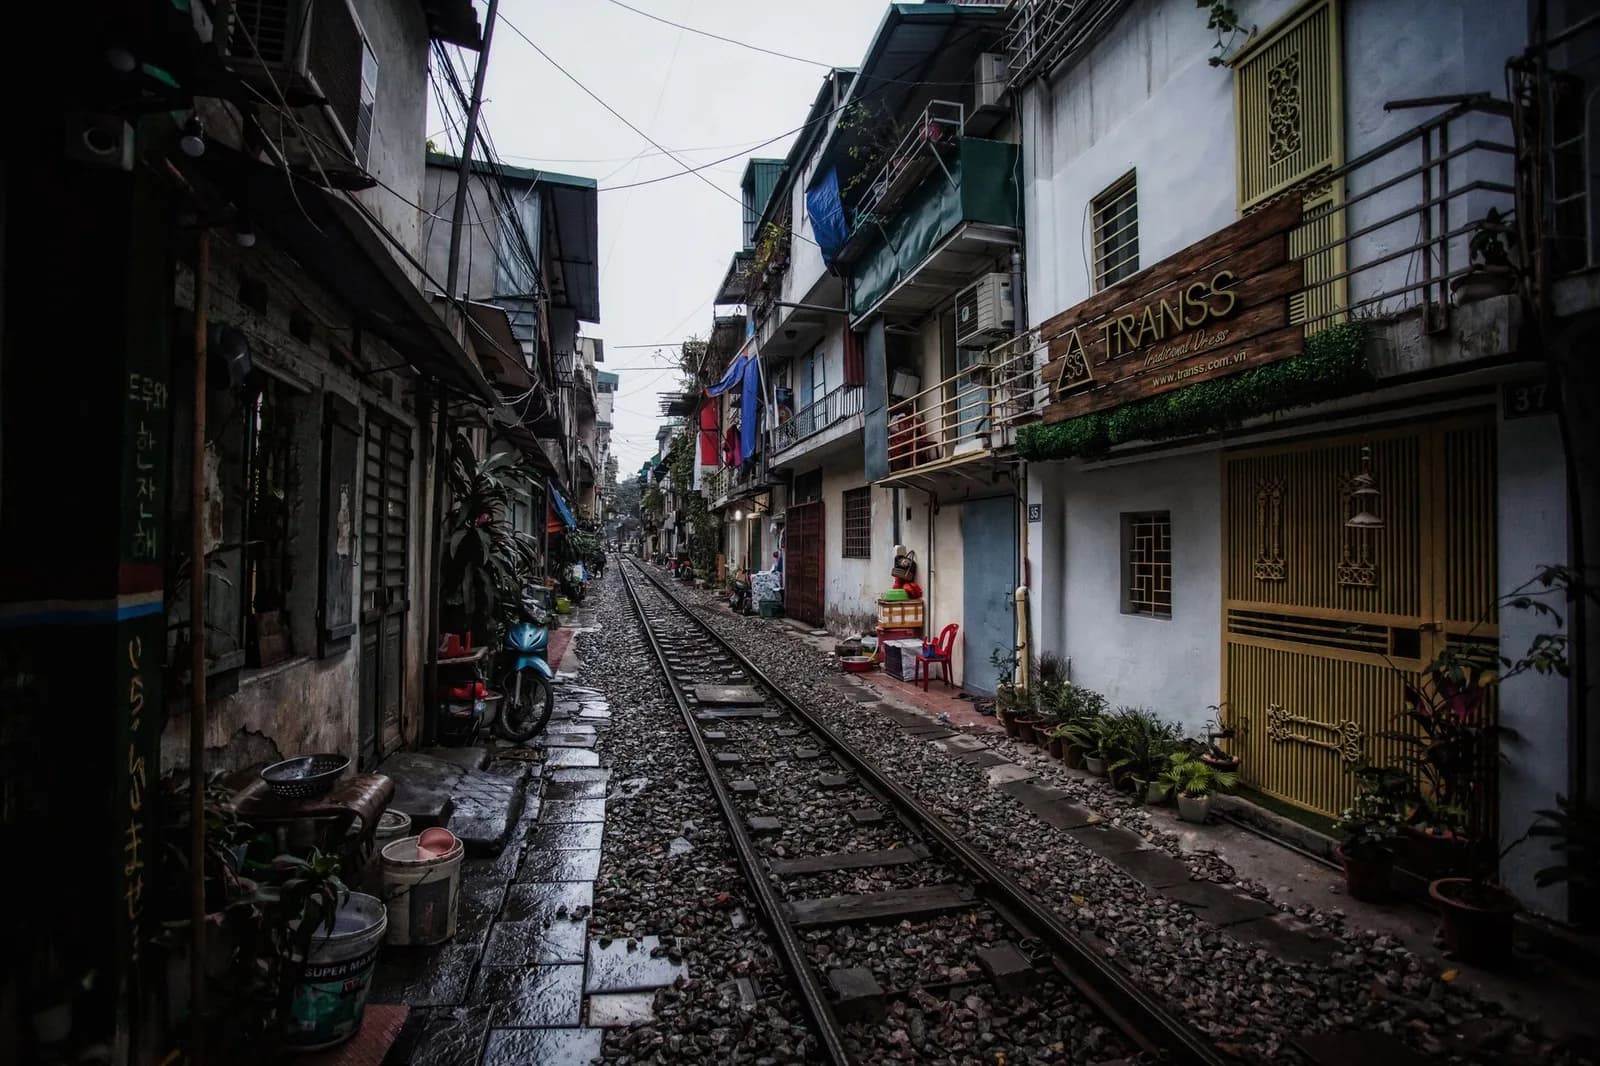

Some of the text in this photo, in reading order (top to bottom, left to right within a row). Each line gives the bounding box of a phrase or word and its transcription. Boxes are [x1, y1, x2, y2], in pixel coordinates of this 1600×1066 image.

[1098, 270, 1237, 359] TRANSS
[1143, 328, 1229, 366] Traditional Dress
[1152, 351, 1247, 387] www.transs.com.vn
[1514, 384, 1547, 411] 37
[304, 965, 347, 977] SUPER
